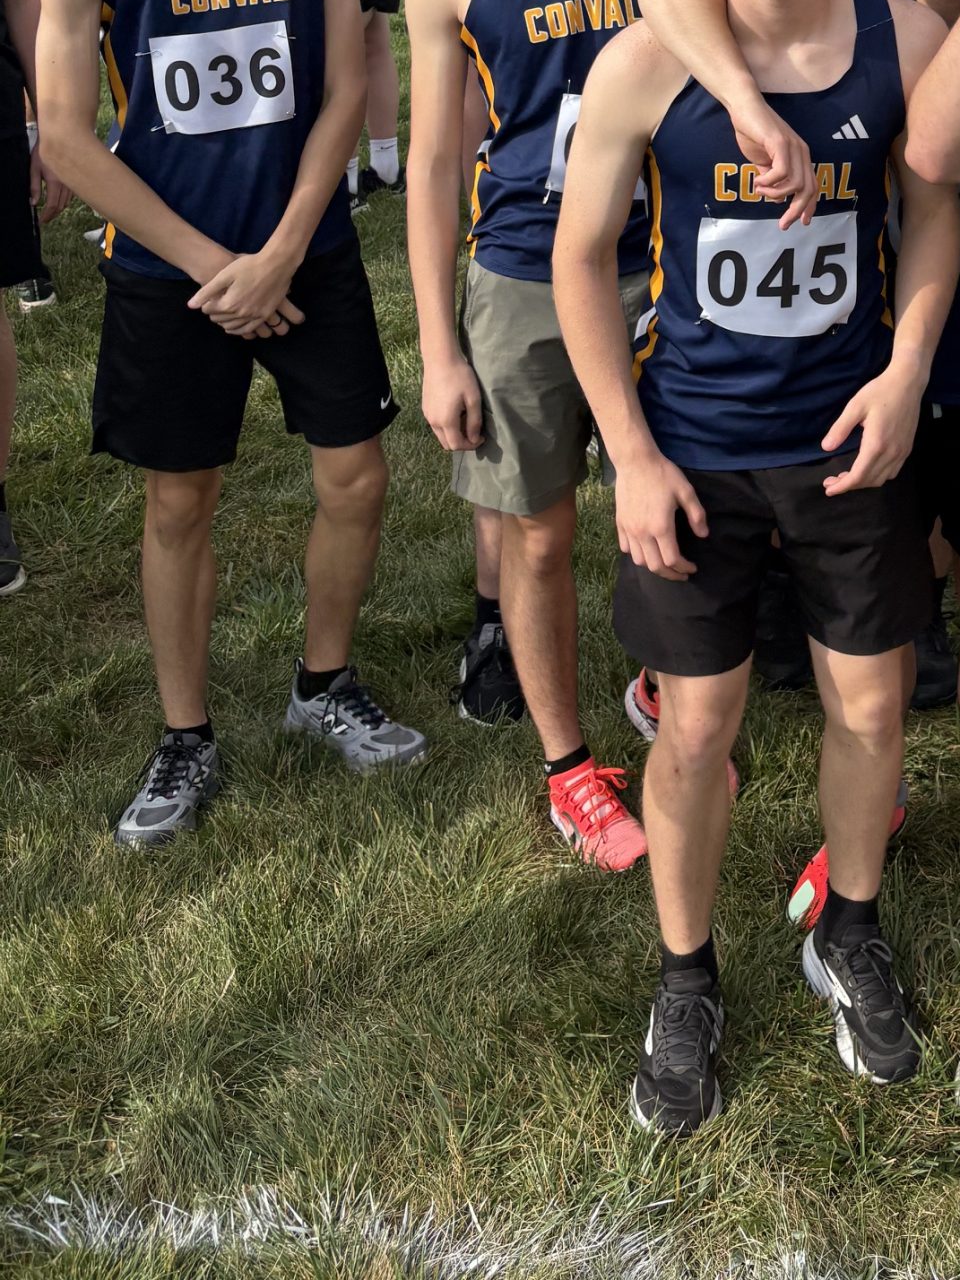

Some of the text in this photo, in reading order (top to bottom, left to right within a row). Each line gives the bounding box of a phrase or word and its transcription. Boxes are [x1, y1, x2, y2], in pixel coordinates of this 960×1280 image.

[165, 47, 286, 112] 036
[714, 163, 857, 202] COAL
[707, 242, 848, 308] 045
